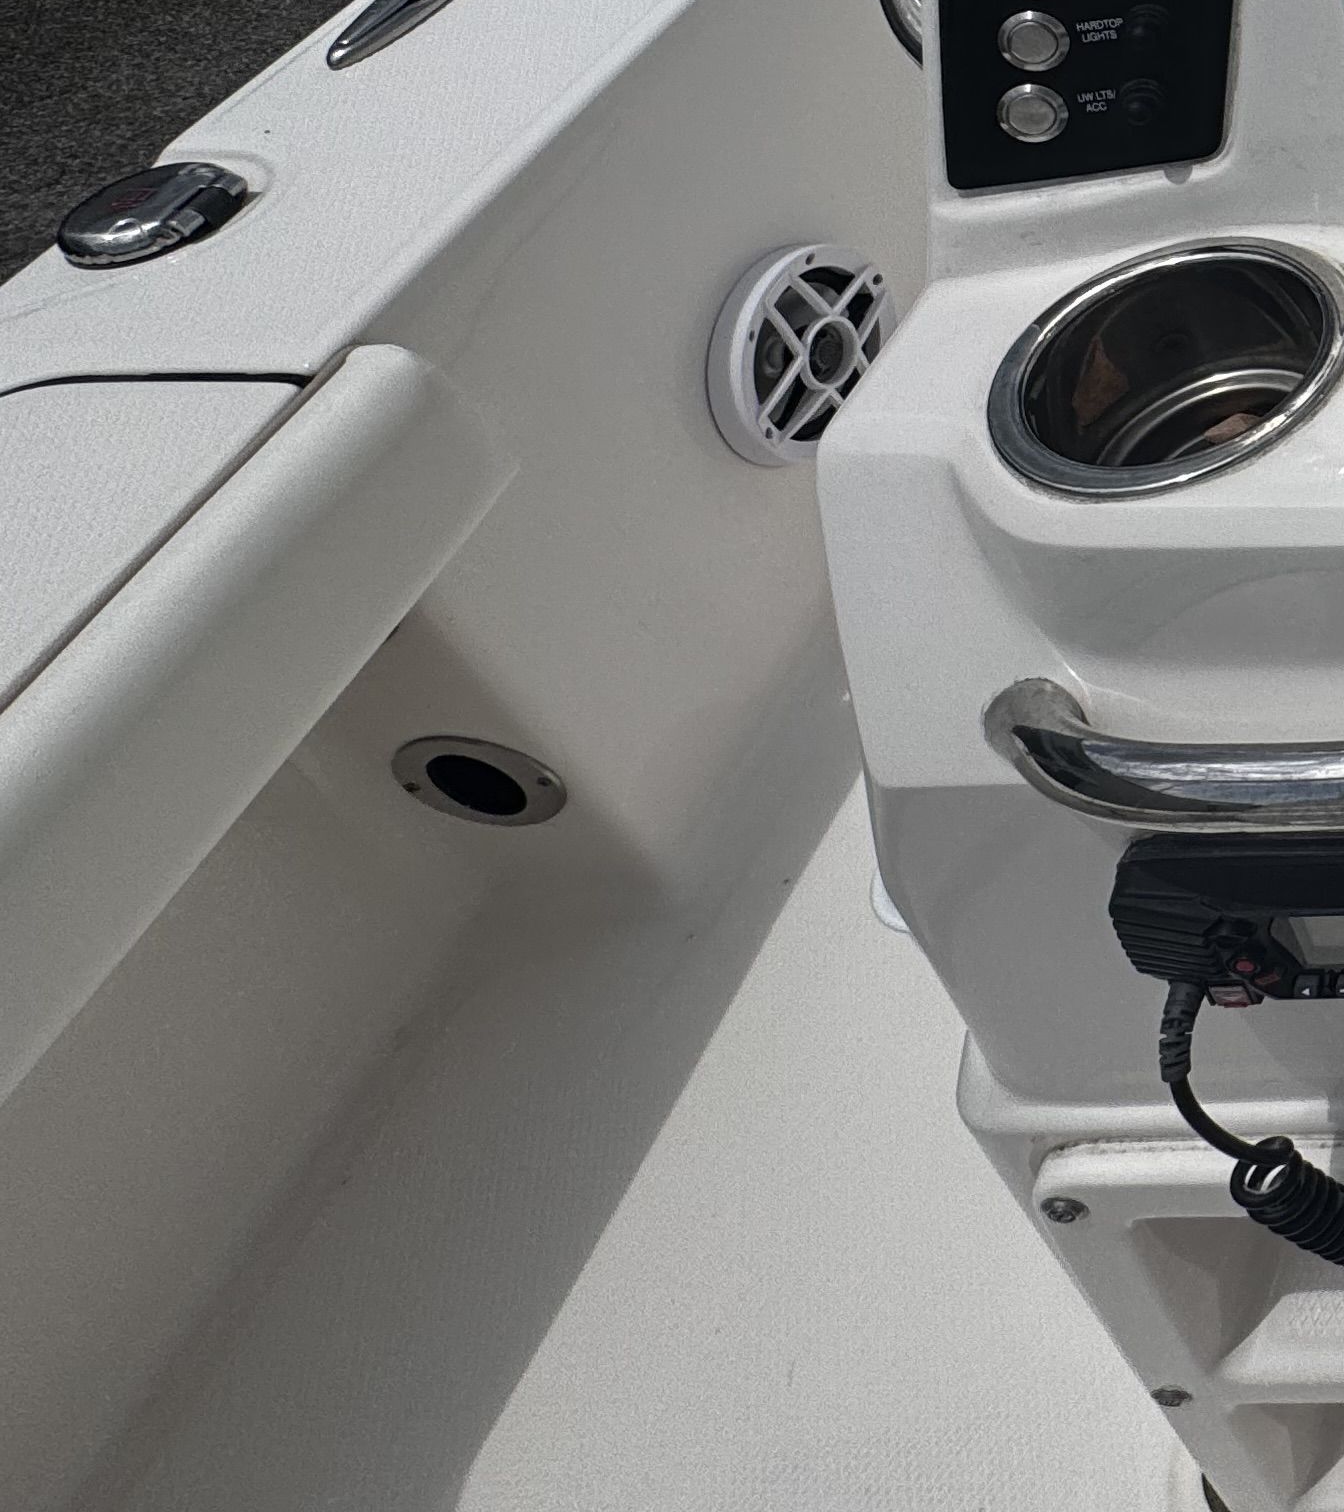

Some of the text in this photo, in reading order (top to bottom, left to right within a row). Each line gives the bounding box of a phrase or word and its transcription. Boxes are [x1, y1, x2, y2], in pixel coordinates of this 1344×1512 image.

[1076, 18, 1123, 32] HARDTOP
[1082, 30, 1118, 43] LIGHTS
[1077, 91, 1094, 103] UW
[1086, 101, 1107, 113] ACC
